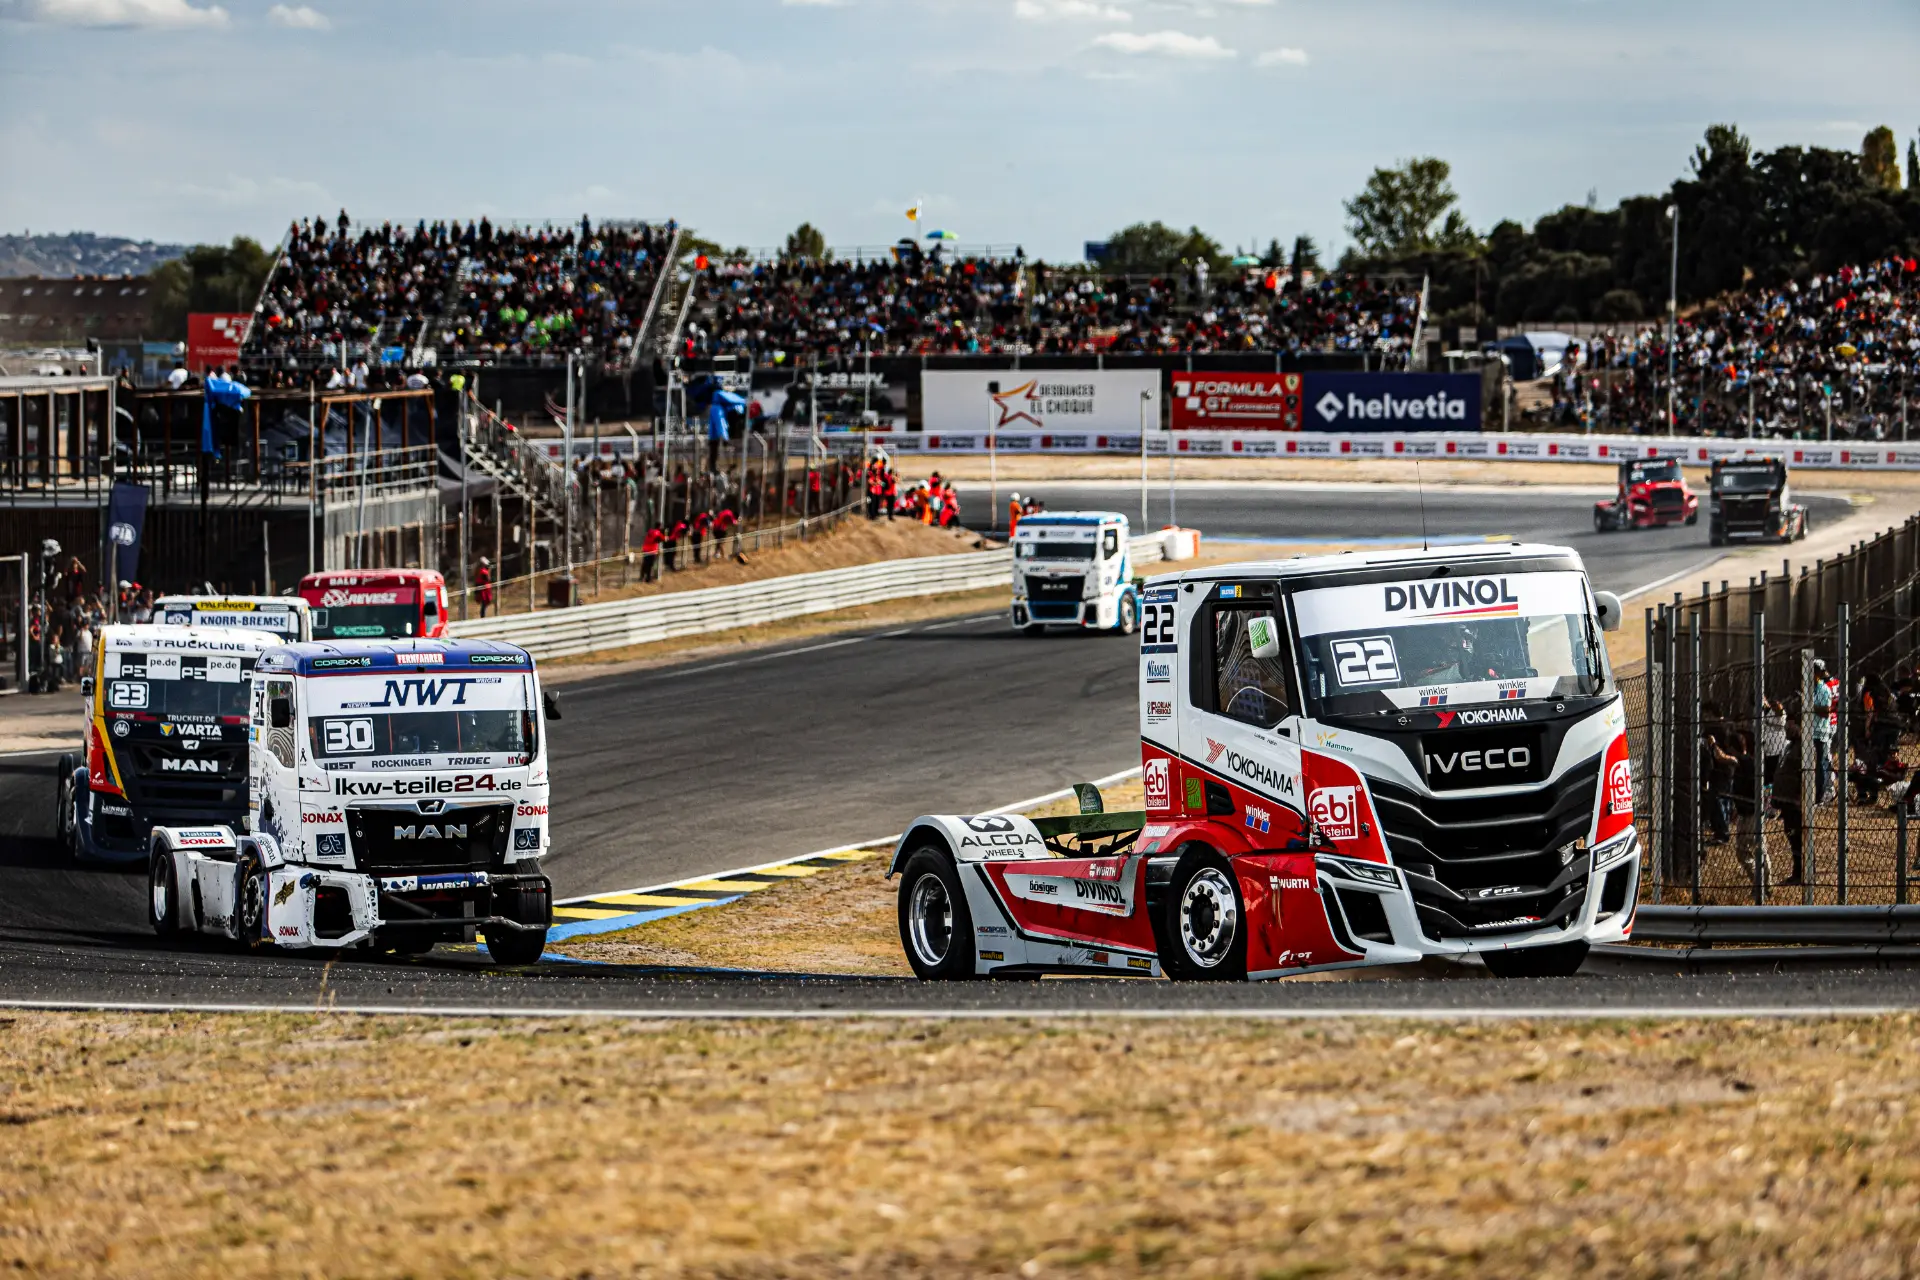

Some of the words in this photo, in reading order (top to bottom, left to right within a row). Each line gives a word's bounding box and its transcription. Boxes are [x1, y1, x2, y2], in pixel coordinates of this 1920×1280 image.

[1194, 381, 1283, 397] FORMULA
[1347, 390, 1466, 420] helvetia
[1384, 578, 1519, 612] DIVINOL
[200, 601, 252, 609] PALFINGER
[200, 615, 287, 627] KNORR-BREMSE
[1143, 604, 1175, 644] 22
[153, 639, 247, 651] TRUCKLINE
[150, 659, 177, 668] pe.de
[210, 661, 237, 670] pe.de
[396, 653, 444, 664] FERNFAHRER
[1335, 639, 1398, 683] 22
[121, 664, 147, 677] PE
[182, 667, 207, 680] PE
[1146, 659, 1170, 677] Nissens
[1418, 686, 1449, 697] winkler
[1497, 680, 1527, 690] winkler
[114, 684, 146, 706] 23
[383, 678, 472, 707] NWT
[167, 714, 216, 723] TRUCKFIT.DE
[1457, 707, 1528, 725] YOKOHAMA
[176, 723, 222, 737] VARTA
[326, 720, 373, 751] 30
[1325, 740, 1354, 753] Hammer
[161, 758, 219, 773] MAN
[324, 761, 356, 771] JOST
[371, 758, 432, 769] ROCKINGER
[447, 756, 491, 766] TRIDEC
[1424, 746, 1531, 775] IVECO
[1144, 760, 1168, 796] febi
[1226, 749, 1295, 797] YOKOHAMA
[335, 774, 522, 796] lkw-teile24.de
[1147, 796, 1167, 807] bilstein
[1308, 790, 1355, 824] febi
[302, 812, 343, 823] SONAX
[1245, 805, 1271, 822] winkler
[394, 824, 468, 840] MAN
[960, 833, 1043, 848] ALCOA
[985, 848, 1026, 857] WHEELS
[1278, 877, 1310, 889] WÜRTH
[1074, 880, 1127, 904] DIVINOL
[279, 925, 300, 937] SONAX
